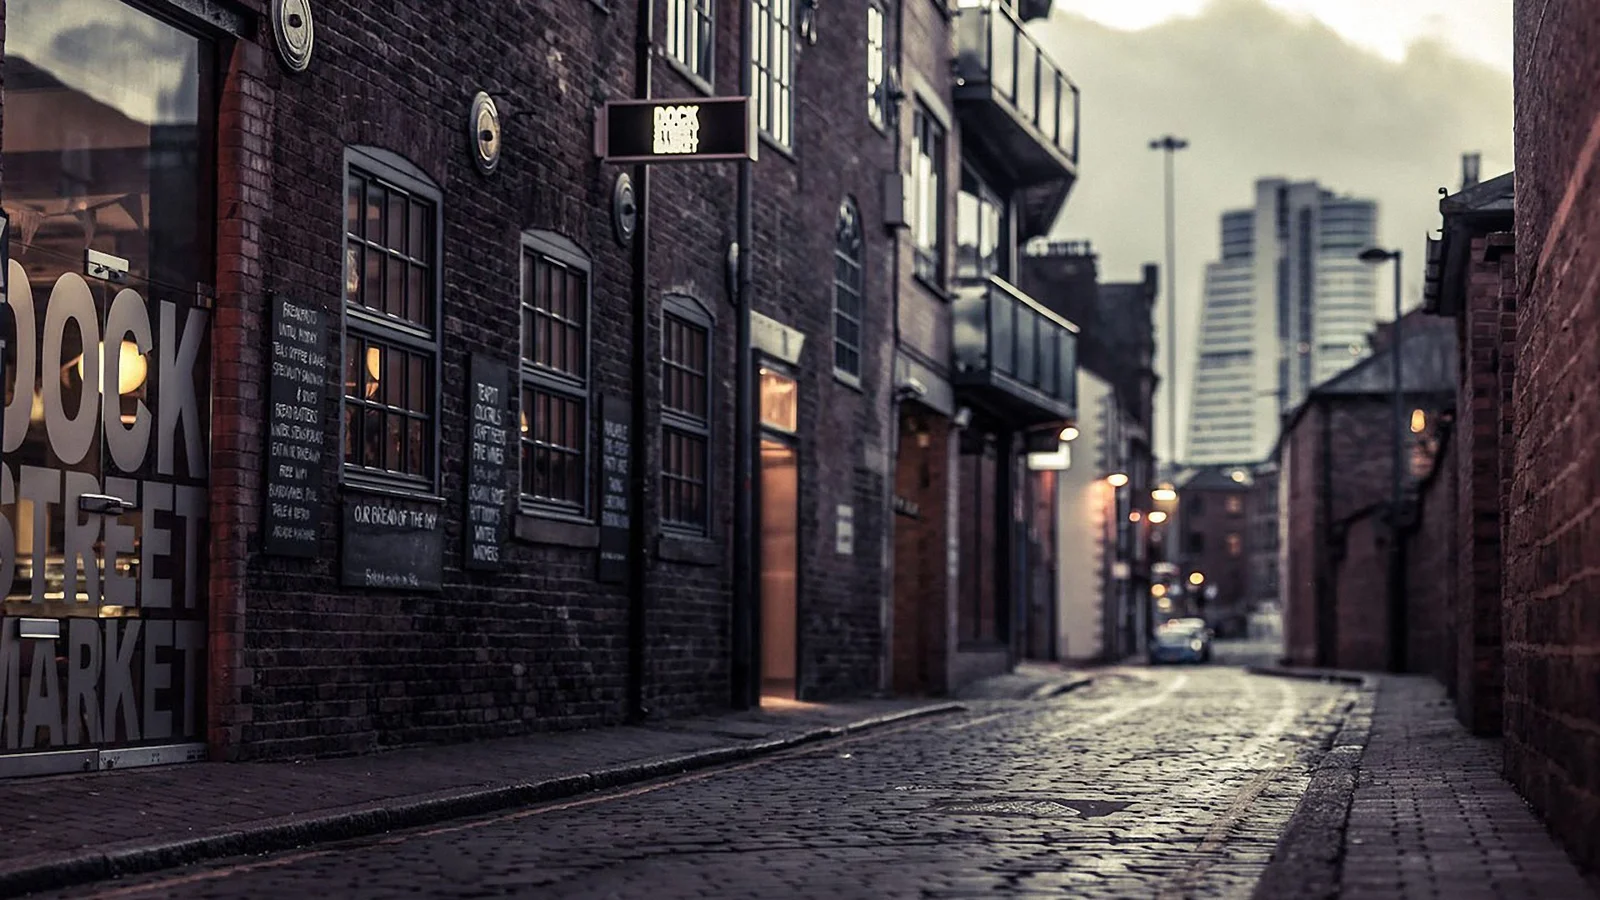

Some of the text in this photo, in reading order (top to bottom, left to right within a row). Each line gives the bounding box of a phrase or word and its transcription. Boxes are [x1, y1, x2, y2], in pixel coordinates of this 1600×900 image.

[654, 105, 699, 128] DOCK
[354, 505, 370, 523] OUR
[371, 506, 397, 525] BREAD
[398, 510, 408, 527] OF
[410, 511, 423, 528] THE
